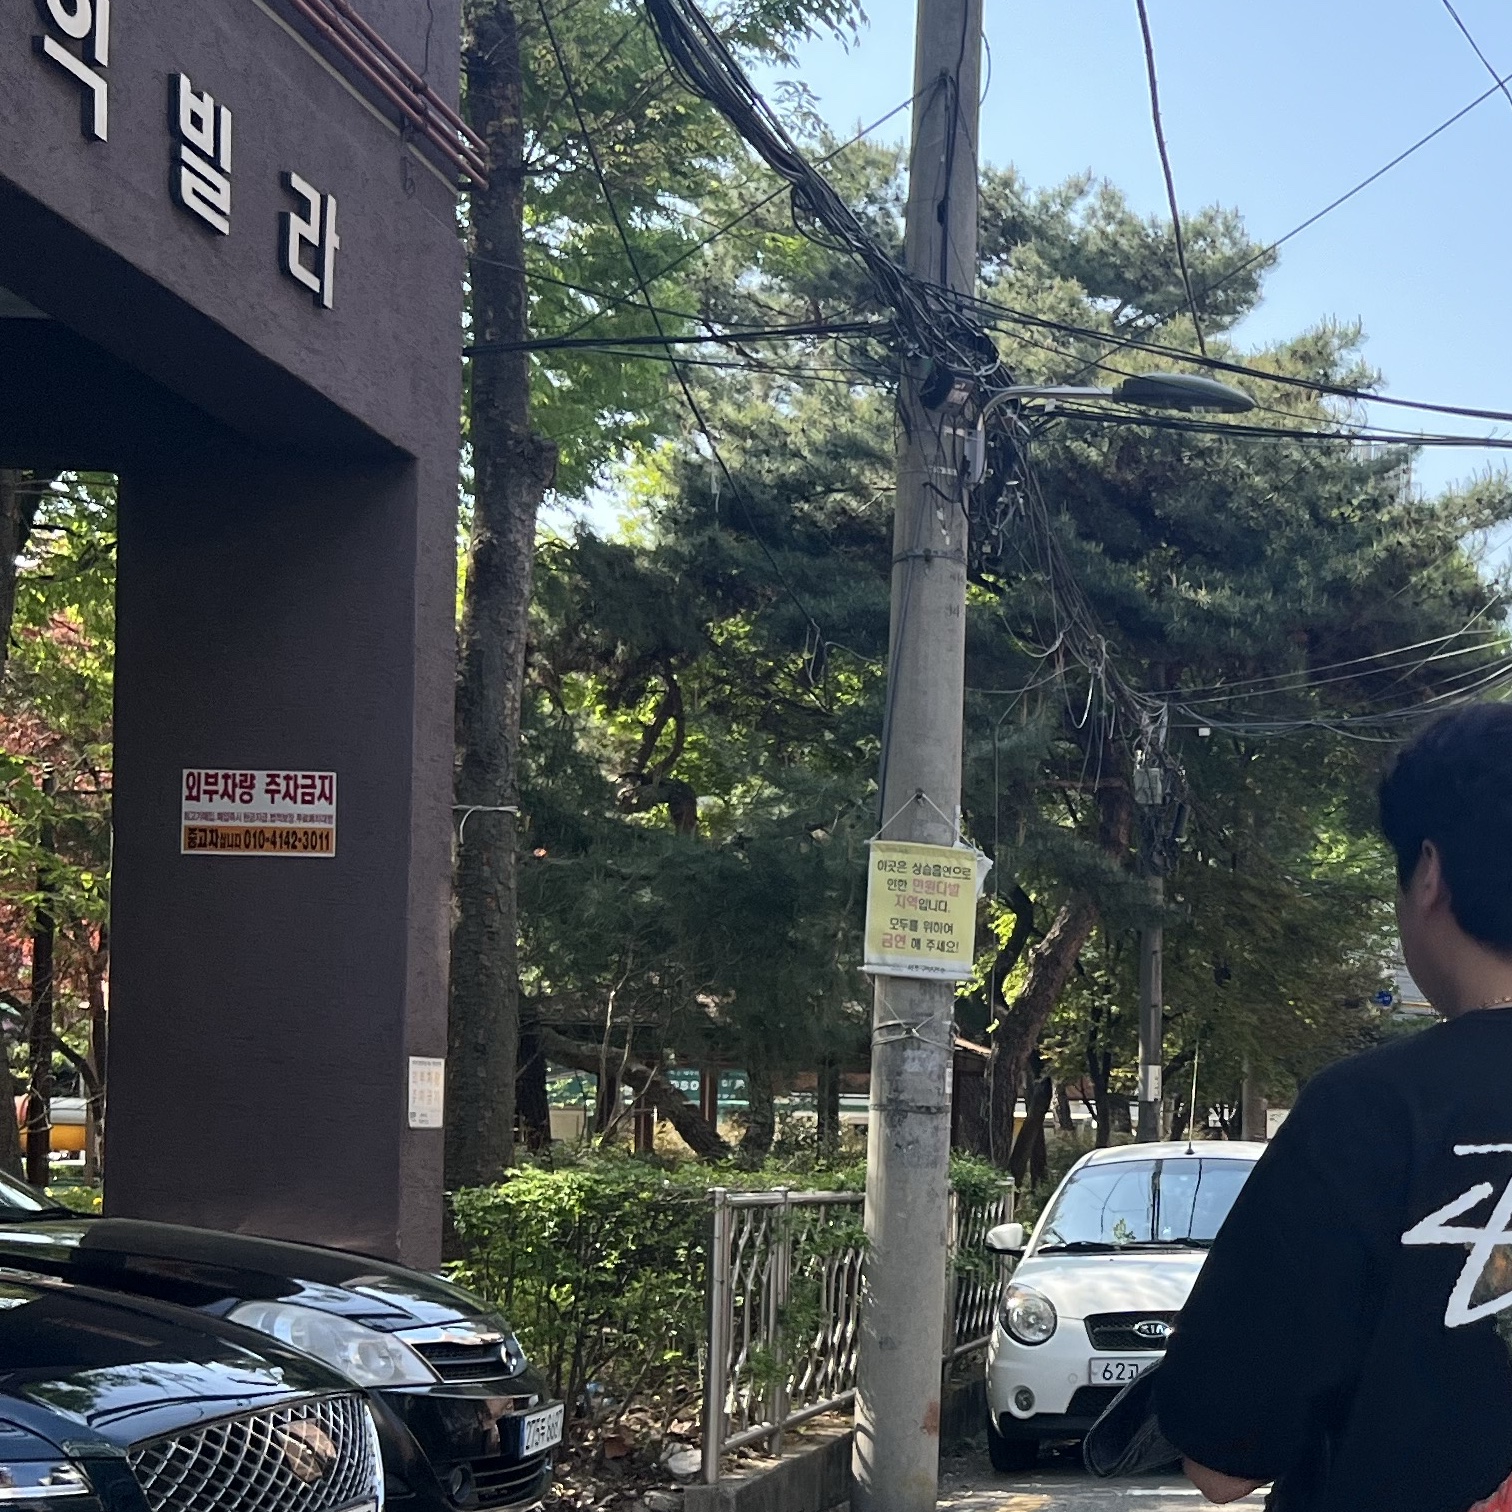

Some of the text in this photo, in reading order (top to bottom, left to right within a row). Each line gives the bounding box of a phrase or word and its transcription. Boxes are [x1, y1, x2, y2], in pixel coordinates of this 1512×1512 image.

[185, 771, 334, 806] 외부차량 주차금지
[243, 828, 331, 851] 010-4142-3011
[877, 859, 972, 880] 이곳은 상습흡연으로
[887, 878, 961, 897] 인한 민원다발
[889, 917, 954, 935] 모두를 위하여
[881, 932, 959, 954] 금연 해 주세요!
